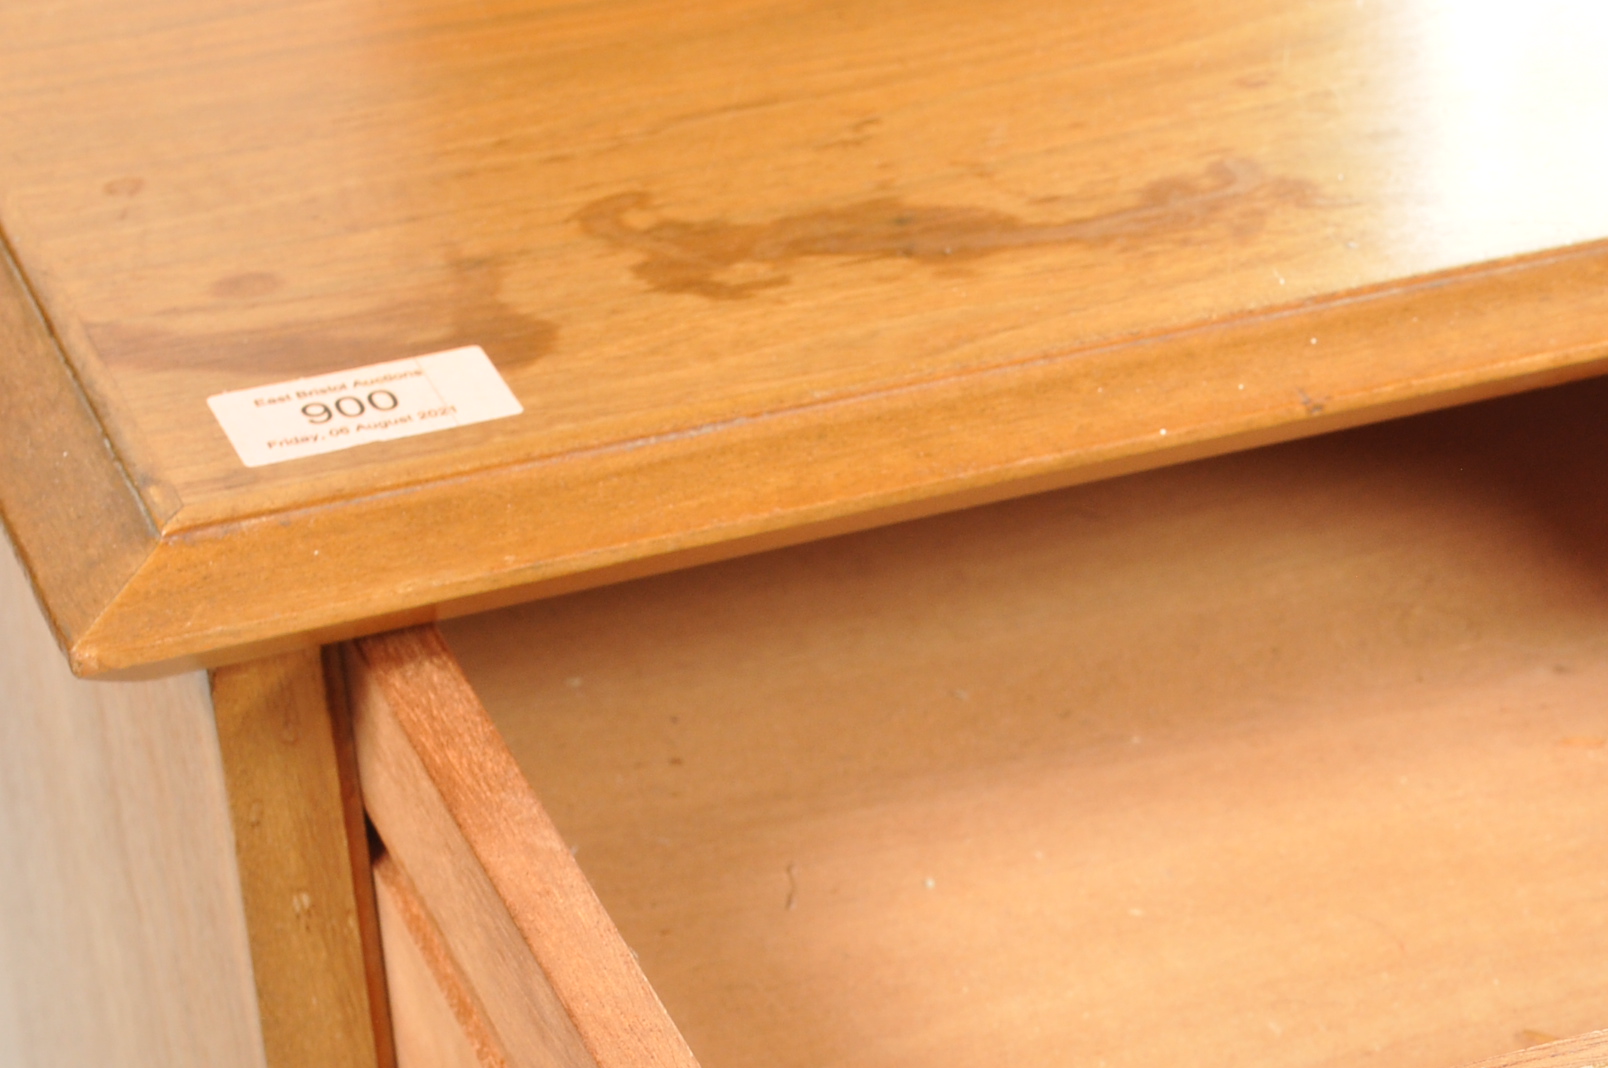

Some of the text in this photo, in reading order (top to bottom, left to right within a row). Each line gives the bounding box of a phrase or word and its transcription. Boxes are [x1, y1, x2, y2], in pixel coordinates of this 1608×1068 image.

[254, 368, 424, 408] East Bristol Auctions
[301, 389, 399, 425] 900
[356, 414, 414, 433] August
[418, 405, 458, 421] 2021
